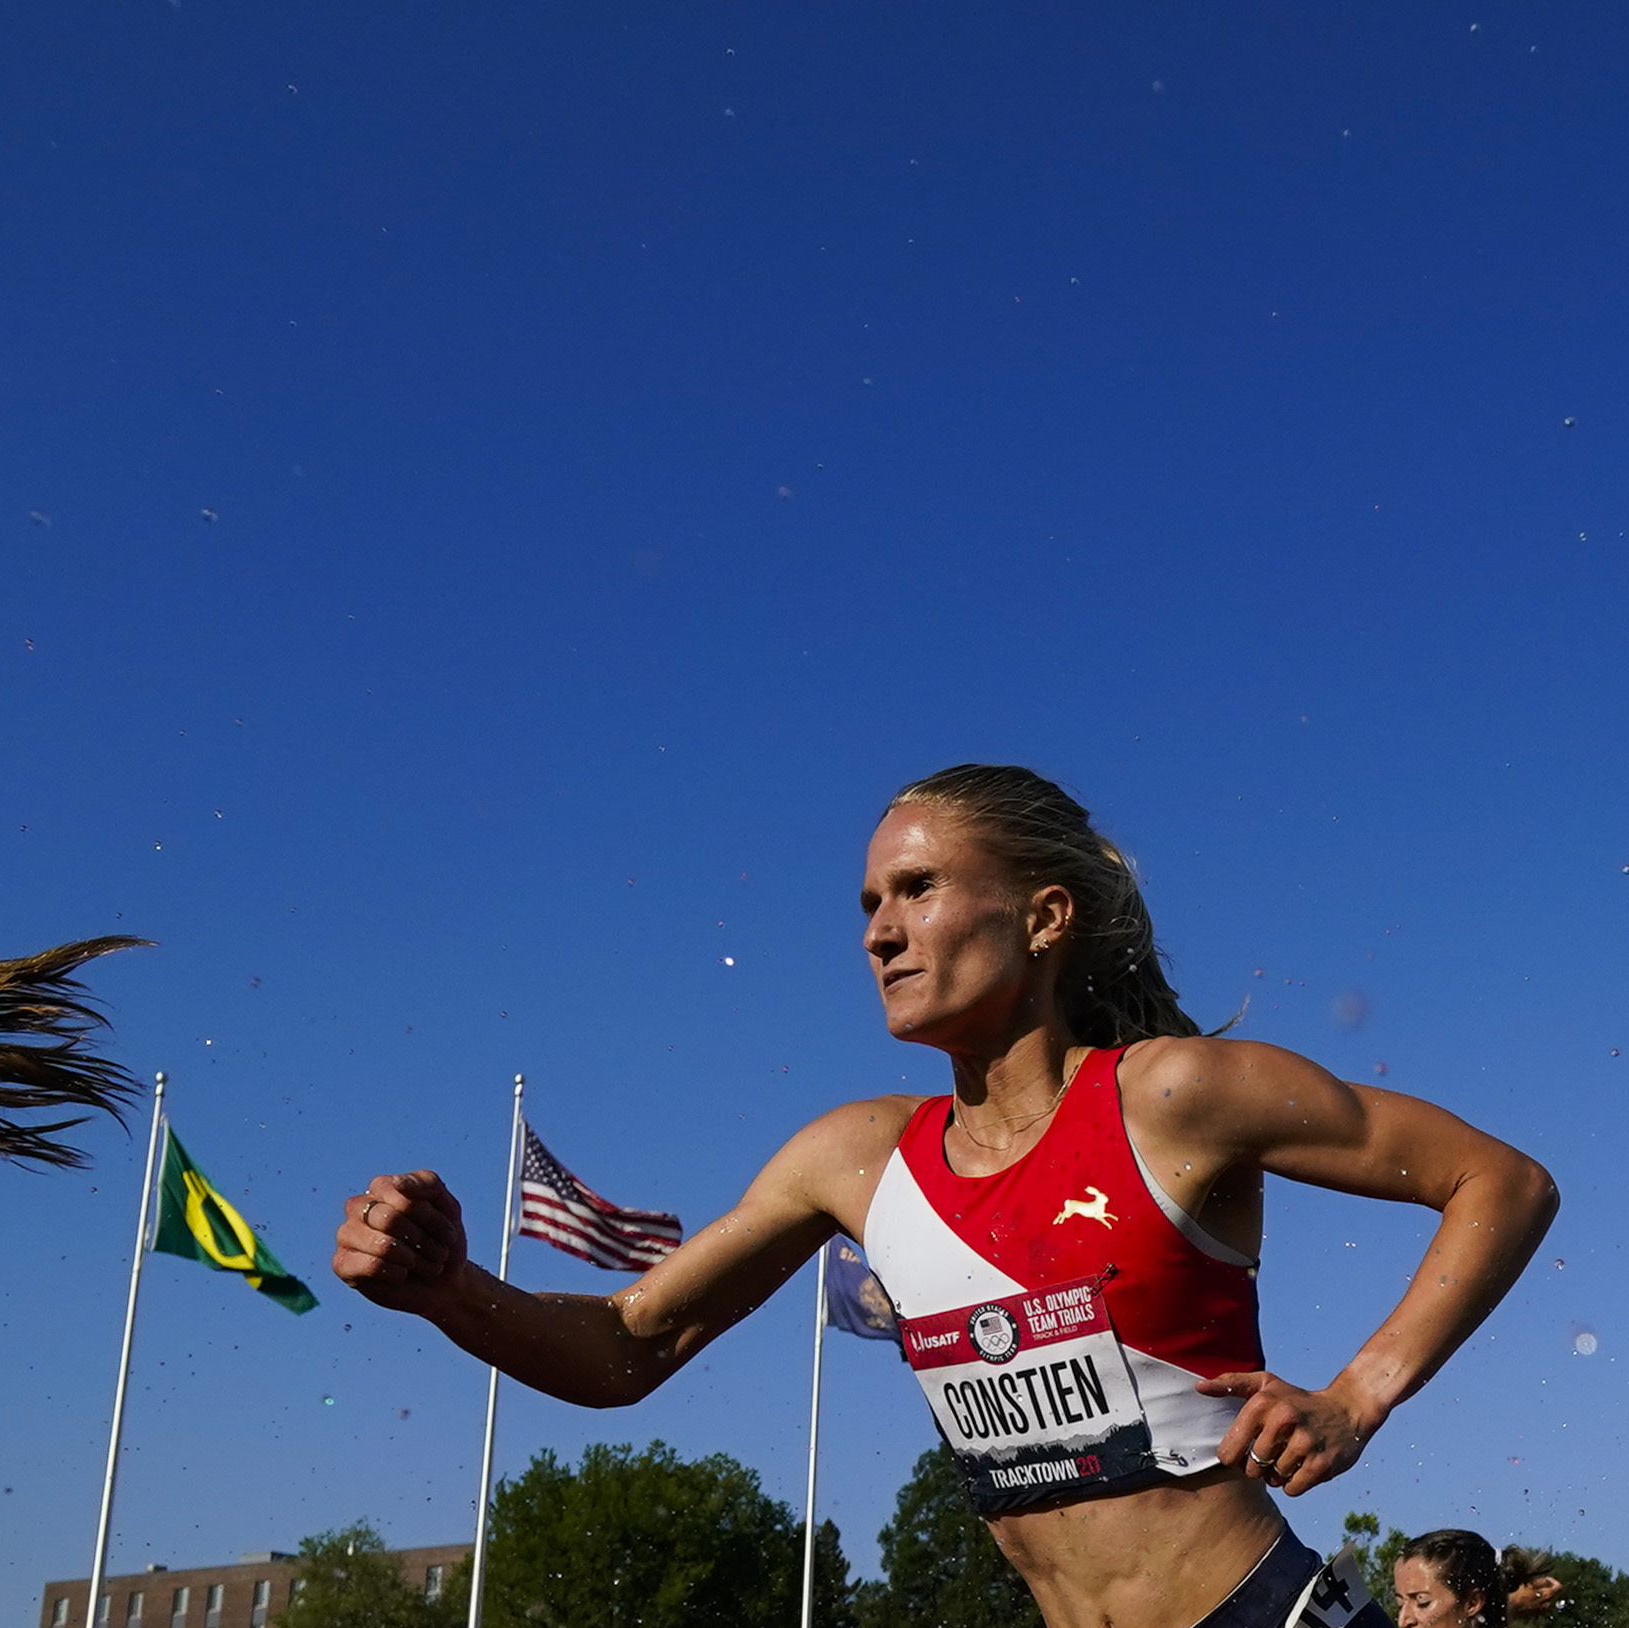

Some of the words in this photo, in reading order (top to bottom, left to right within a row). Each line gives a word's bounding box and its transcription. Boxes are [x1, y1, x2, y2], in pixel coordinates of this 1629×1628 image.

[1023, 1298, 1045, 1317] U.S.
[1045, 1286, 1091, 1311] OLYMPIC
[1027, 1313, 1058, 1333] TEAM
[1057, 1303, 1095, 1326] TRIALS
[924, 1331, 960, 1349] USATF
[943, 1354, 1110, 1440] CONSTIEN
